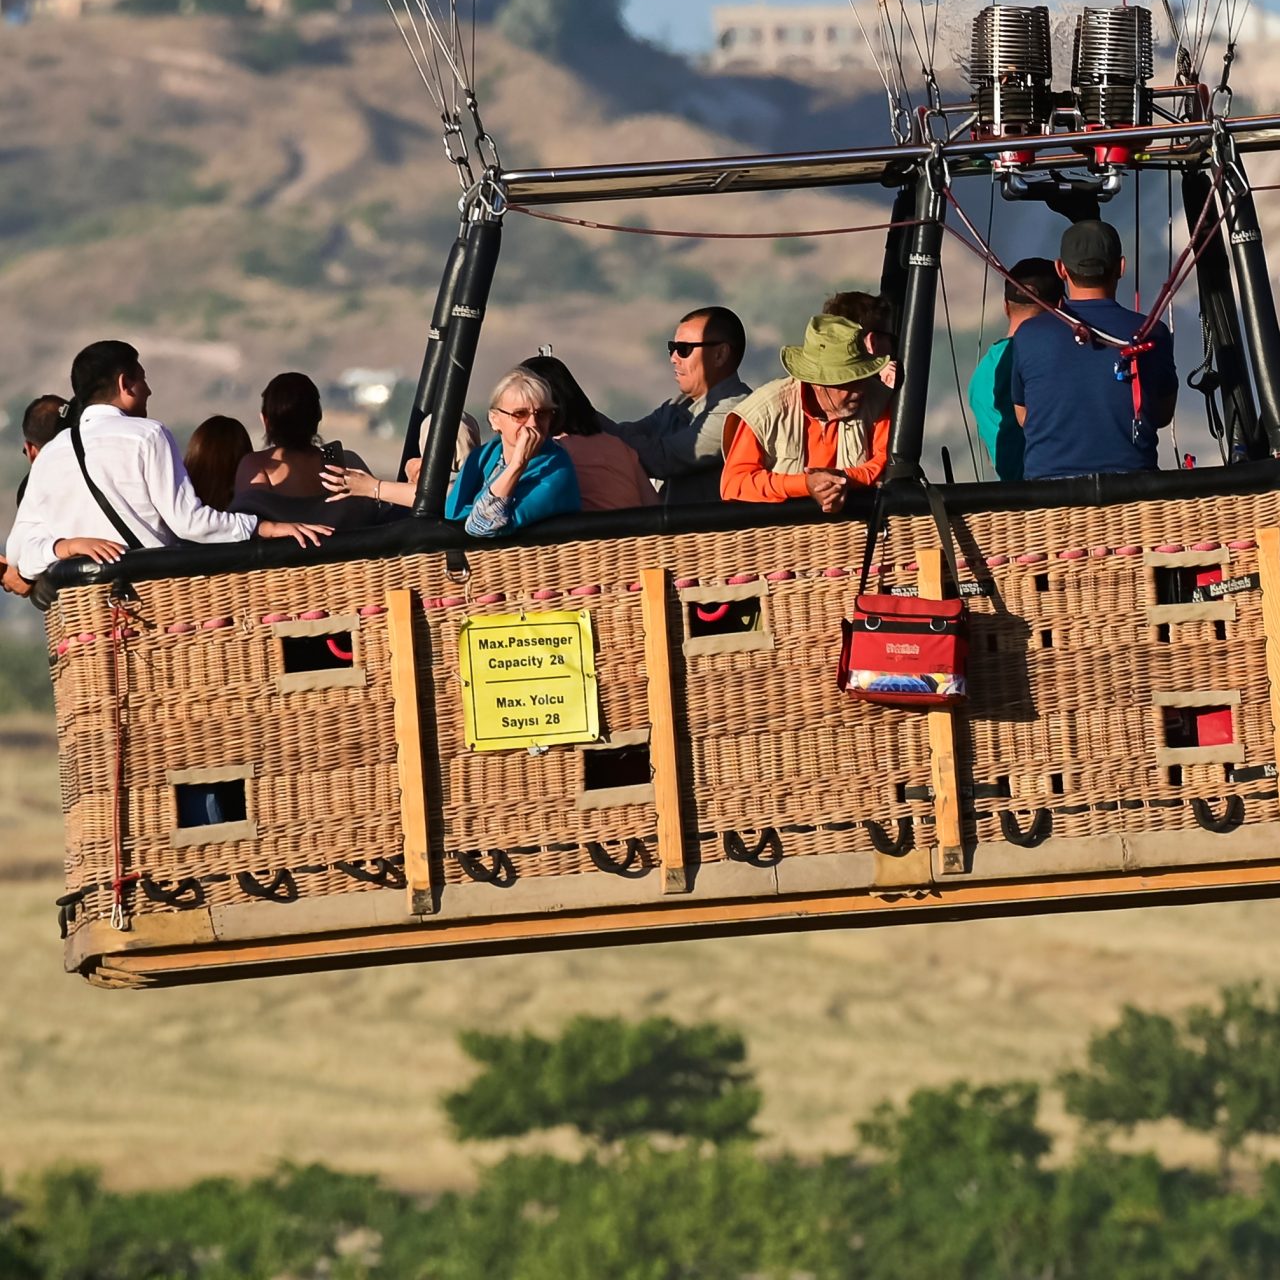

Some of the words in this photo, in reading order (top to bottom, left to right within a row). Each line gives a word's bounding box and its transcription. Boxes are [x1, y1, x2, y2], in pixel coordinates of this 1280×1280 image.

[478, 636, 573, 650] Max.Passenger
[488, 656, 543, 670] Capacity
[550, 655, 565, 665] 28
[496, 696, 526, 708] Max.
[530, 694, 564, 705] Yolcu
[502, 716, 539, 729] Sayısı
[545, 714, 560, 725] 28
